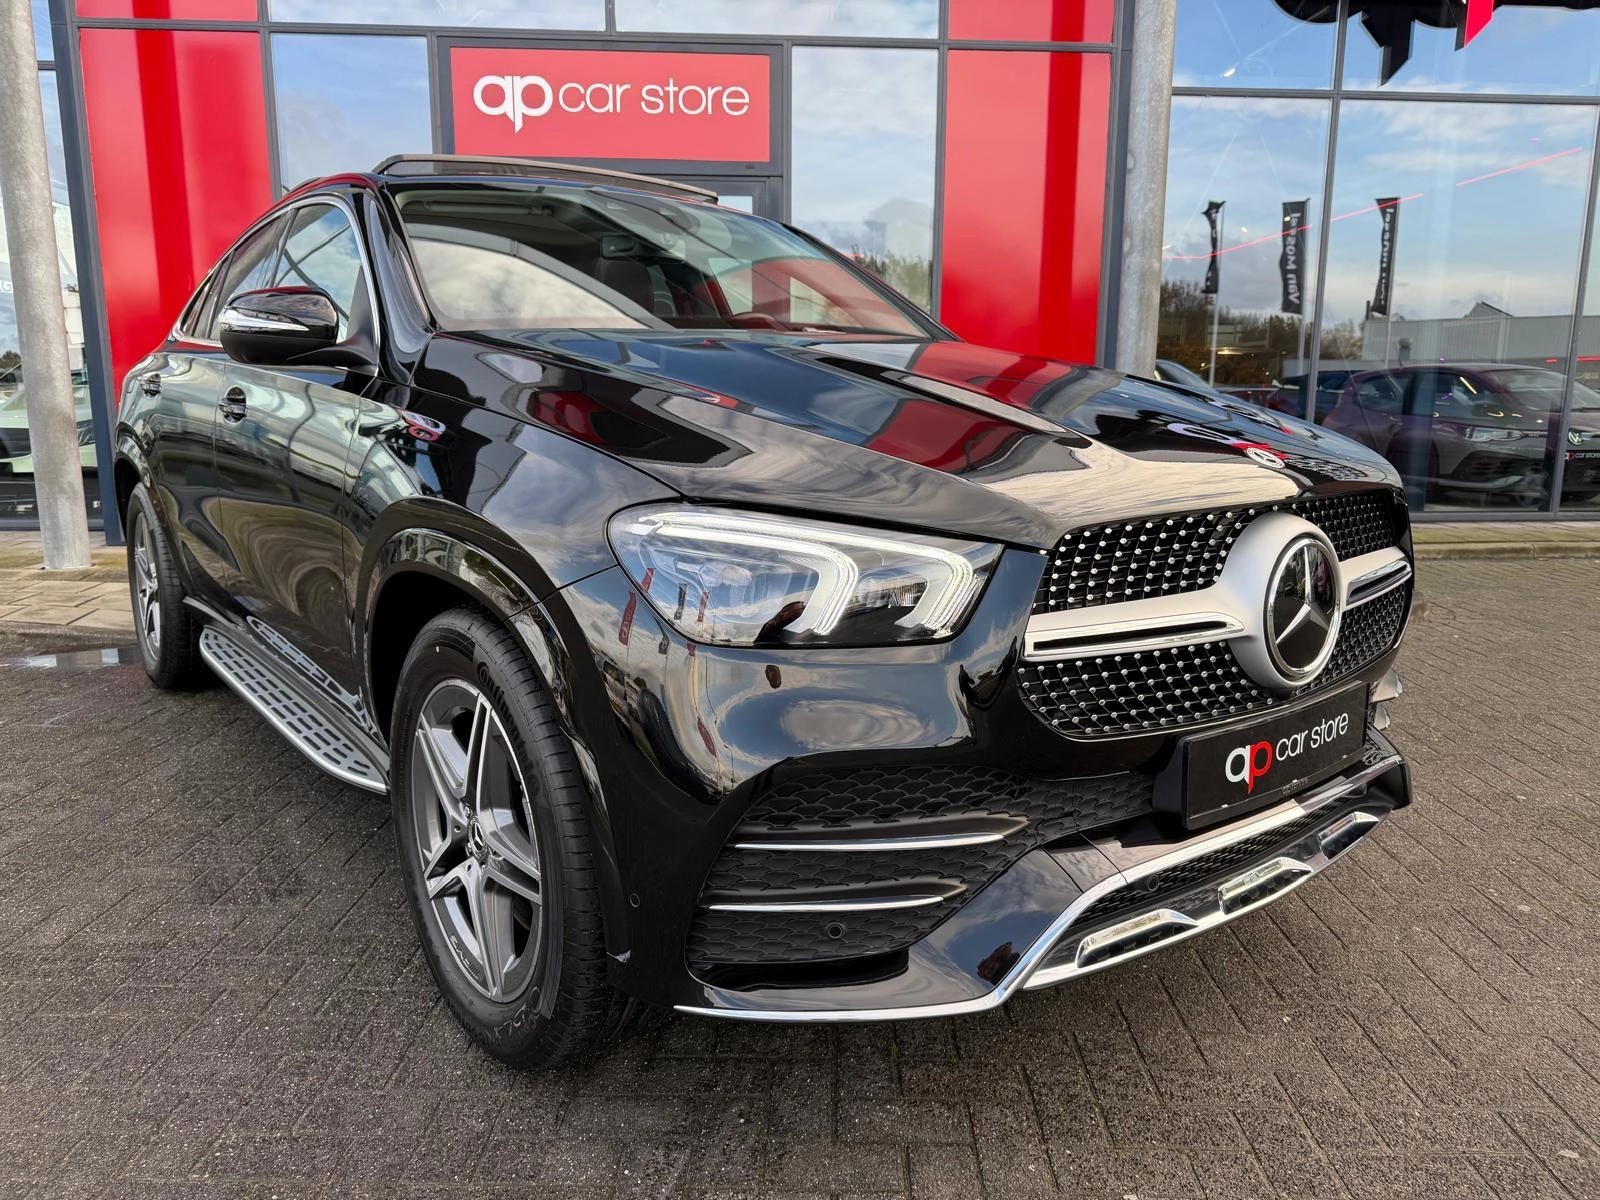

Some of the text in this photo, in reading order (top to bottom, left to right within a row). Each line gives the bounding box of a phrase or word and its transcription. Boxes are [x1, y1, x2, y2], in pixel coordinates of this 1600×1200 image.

[473, 75, 750, 133] ap car store
[1225, 741, 1273, 794] ap
[1275, 730, 1309, 762] car
[1310, 712, 1349, 749] store
